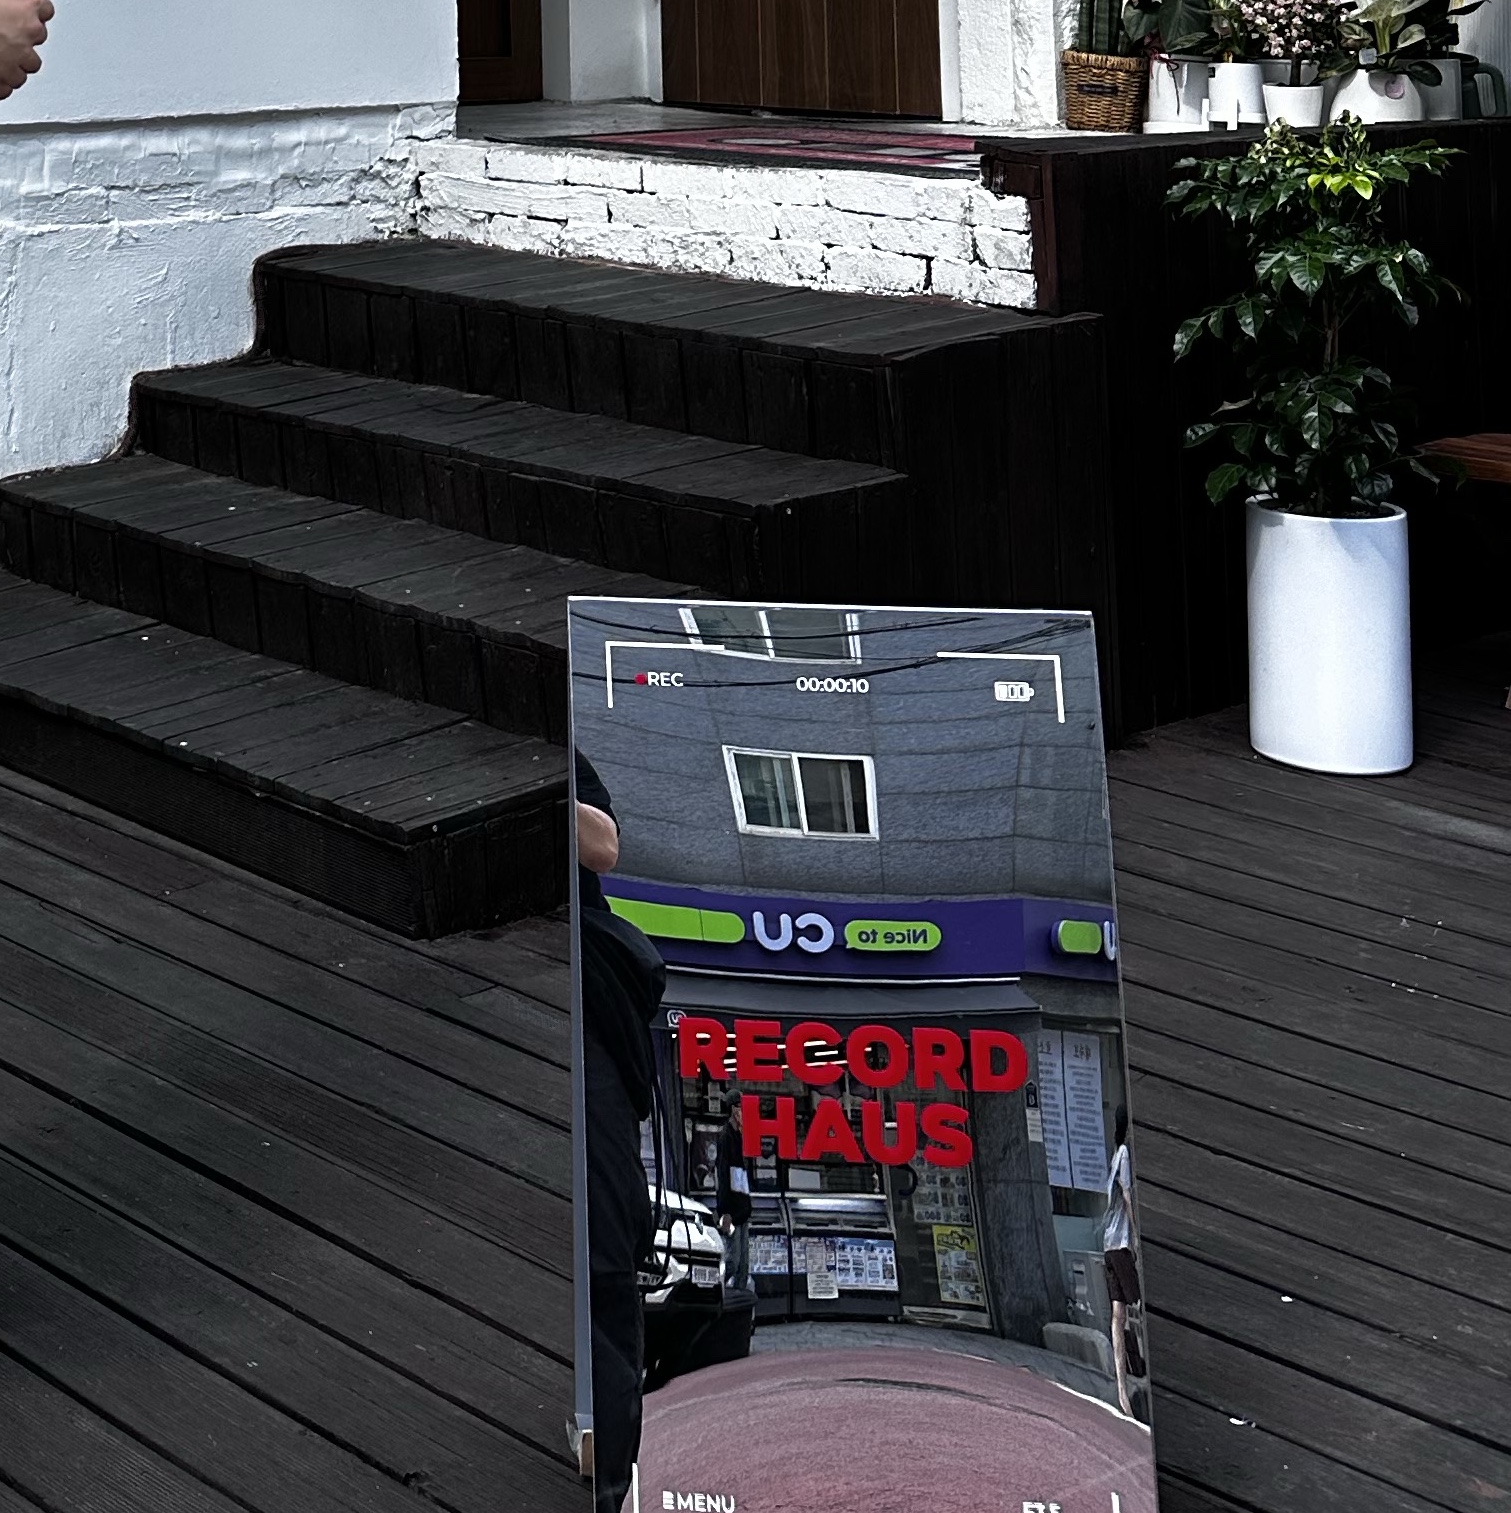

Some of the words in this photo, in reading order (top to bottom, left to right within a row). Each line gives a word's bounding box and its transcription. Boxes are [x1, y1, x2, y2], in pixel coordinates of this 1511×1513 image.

[647, 671, 684, 688] REC
[796, 676, 870, 694] 00:00:10
[679, 1017, 1029, 1094] RECORD
[740, 1095, 974, 1169] HAUS
[677, 1491, 735, 1513] MENU
